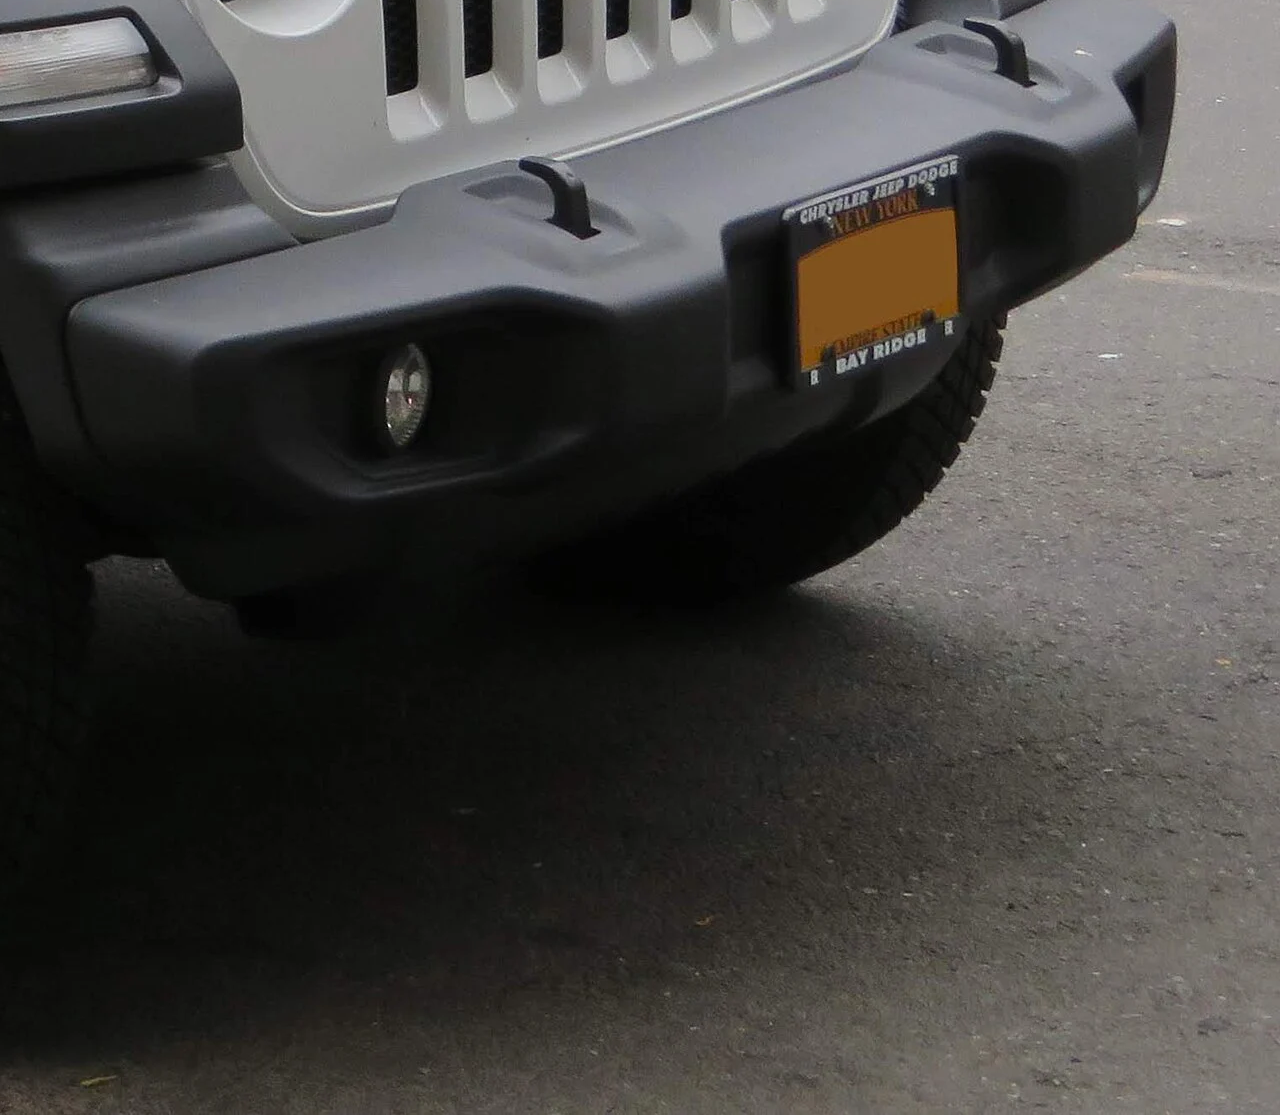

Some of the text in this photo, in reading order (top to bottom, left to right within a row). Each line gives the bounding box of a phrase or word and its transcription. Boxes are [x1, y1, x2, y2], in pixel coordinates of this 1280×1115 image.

[800, 160, 958, 224] CHRYSLER JEEP DODGE
[831, 188, 918, 236] NEW YORK
[836, 348, 869, 374] BAY
[873, 328, 926, 360] RIDGE
